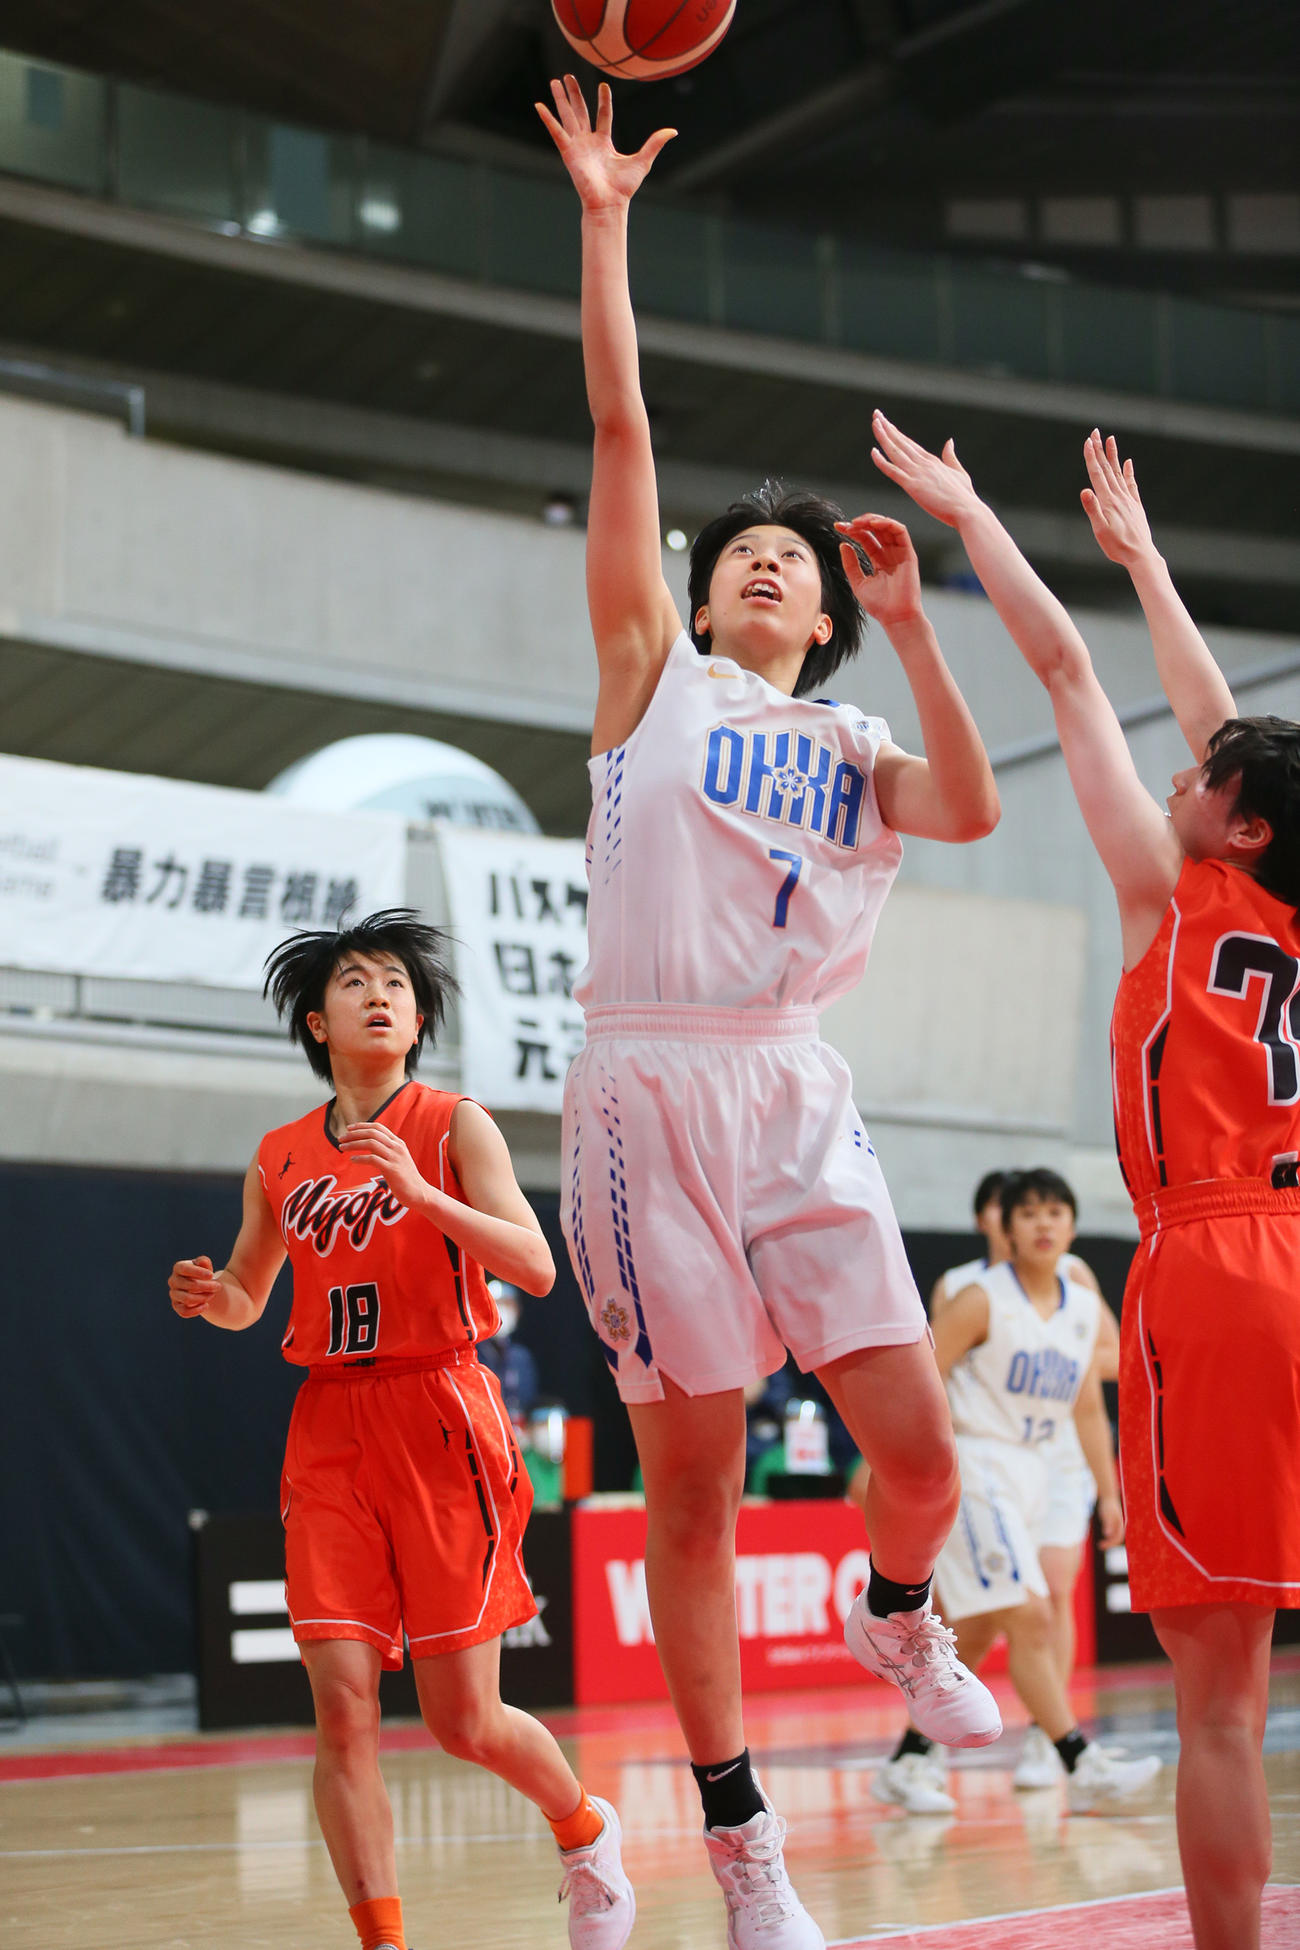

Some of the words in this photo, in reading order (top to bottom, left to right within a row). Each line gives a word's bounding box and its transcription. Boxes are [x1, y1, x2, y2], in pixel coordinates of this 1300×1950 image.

[701, 722, 867, 851] OHKA
[768, 848, 802, 929] 7
[1207, 930, 1300, 1106] 7
[325, 1281, 381, 1357] 18
[605, 1551, 832, 1647] WTER
